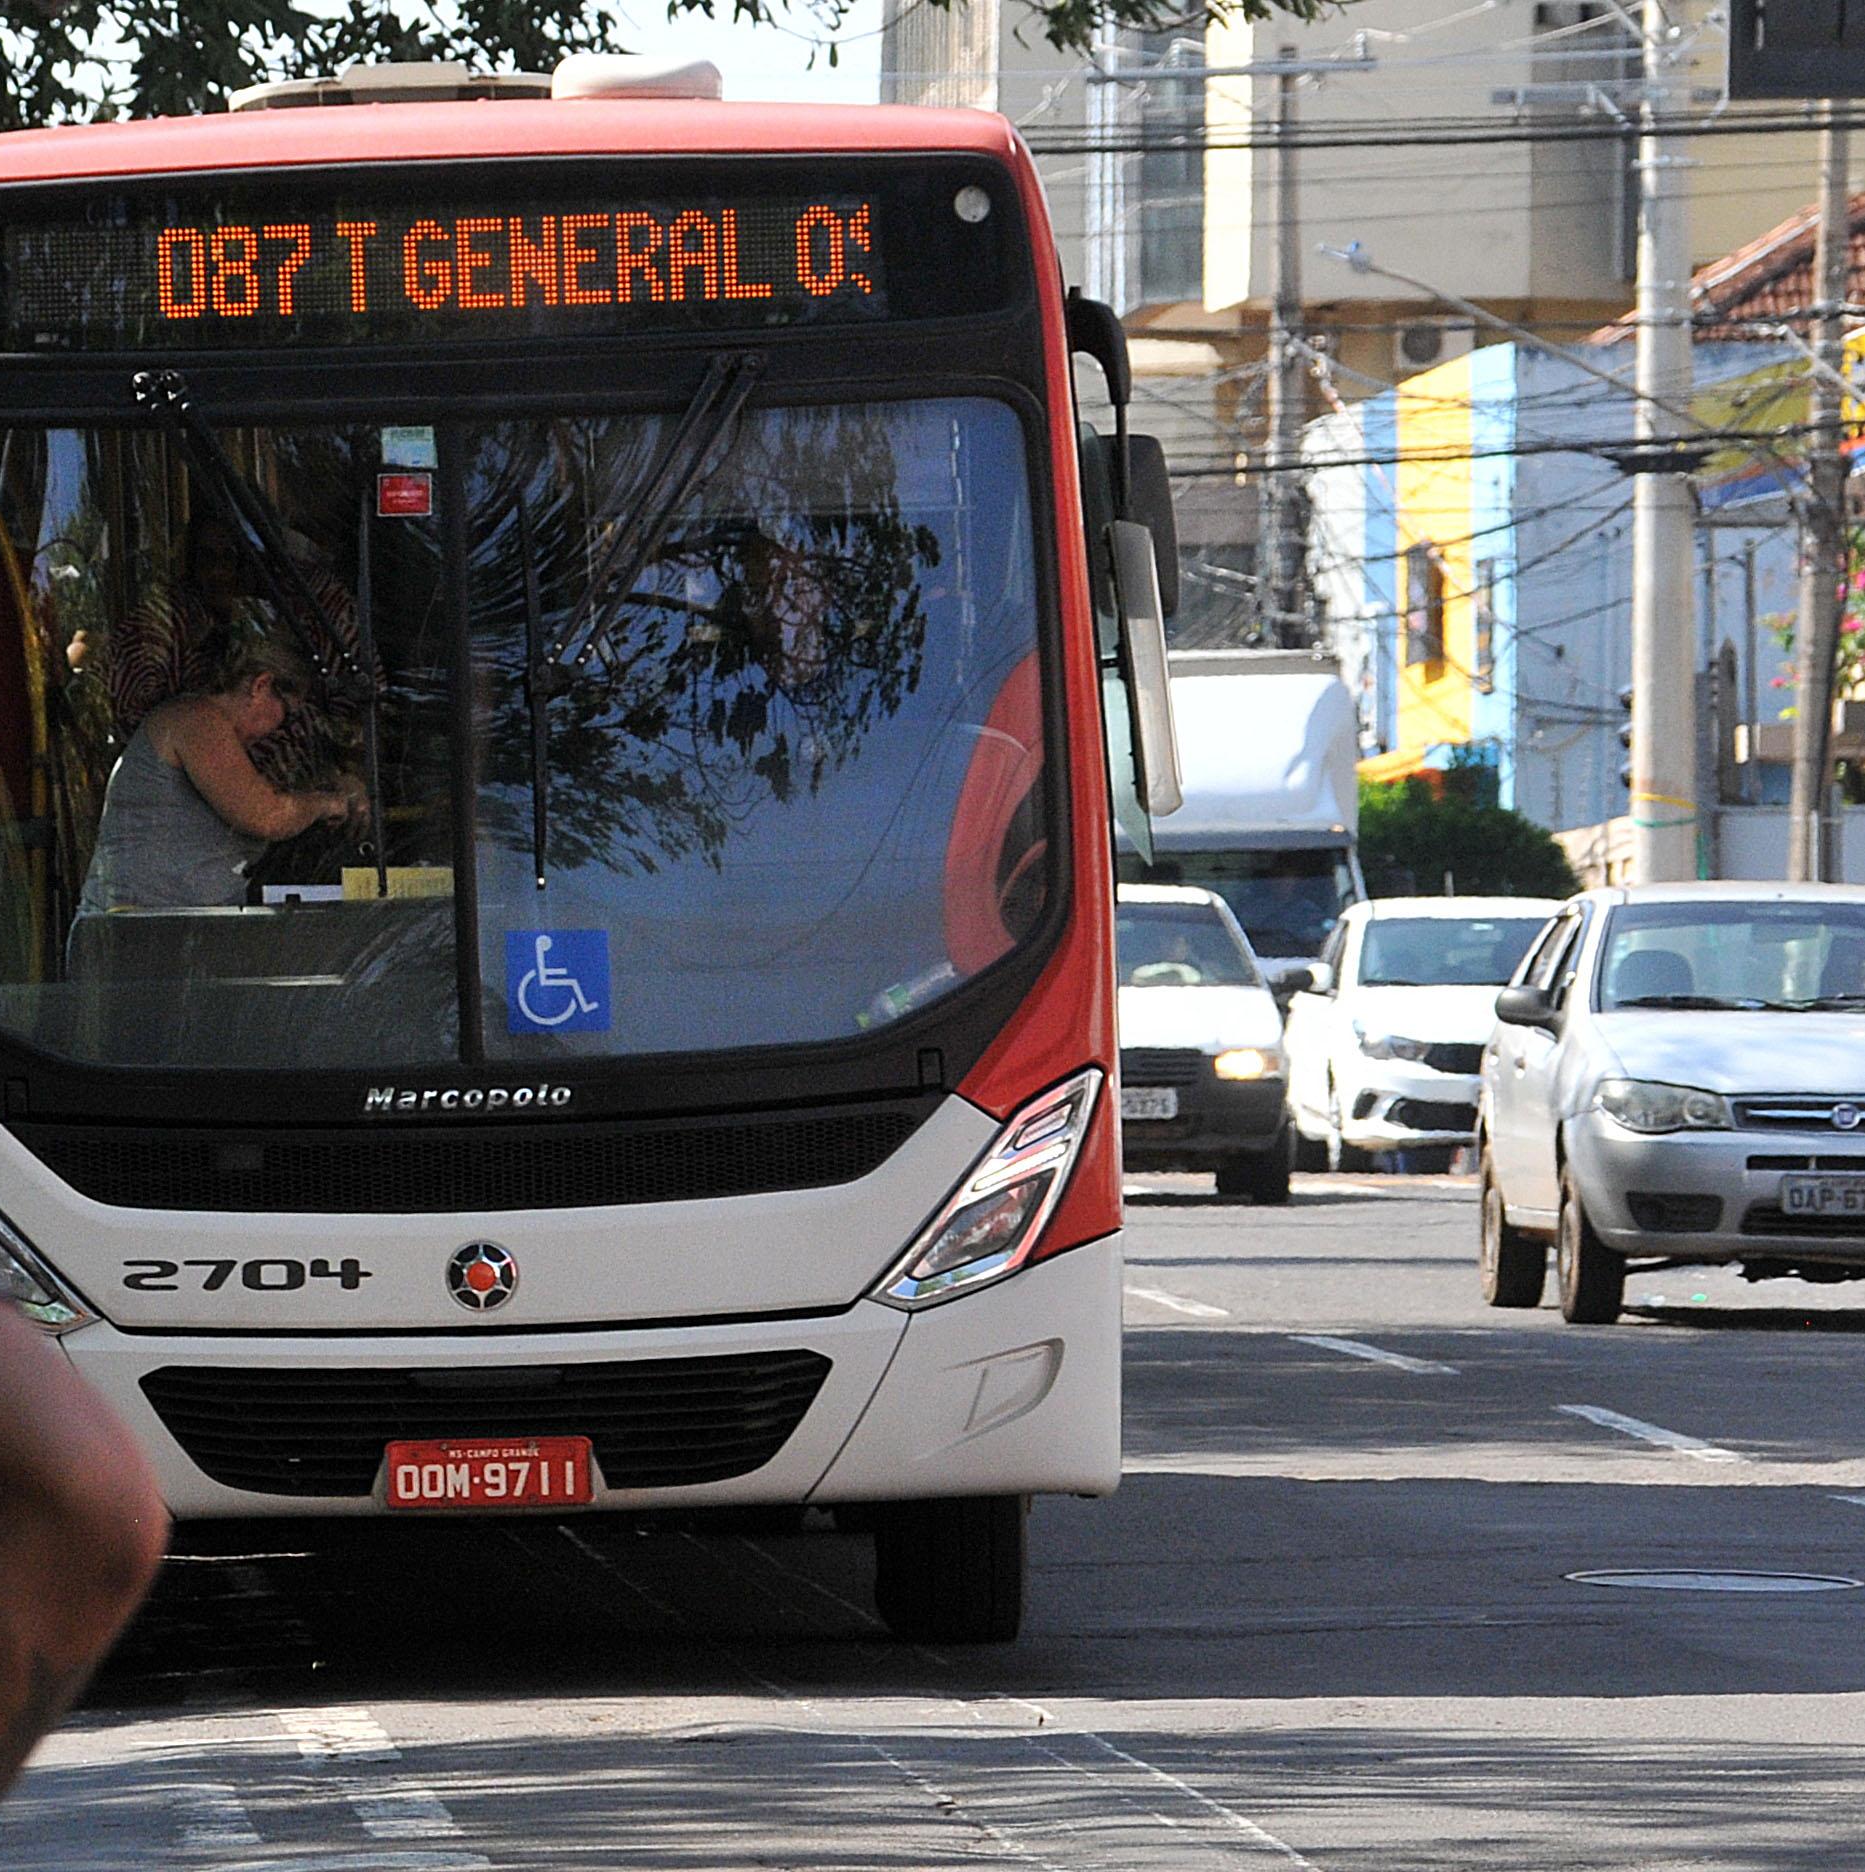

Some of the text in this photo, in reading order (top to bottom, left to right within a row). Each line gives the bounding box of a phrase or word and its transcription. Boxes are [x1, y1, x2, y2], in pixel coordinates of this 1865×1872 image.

[158, 223, 311, 319] 087
[336, 220, 377, 313] T
[403, 208, 772, 310] GENERAL
[364, 1083, 572, 1112] Marcopolo
[123, 1258, 373, 1291] 2704
